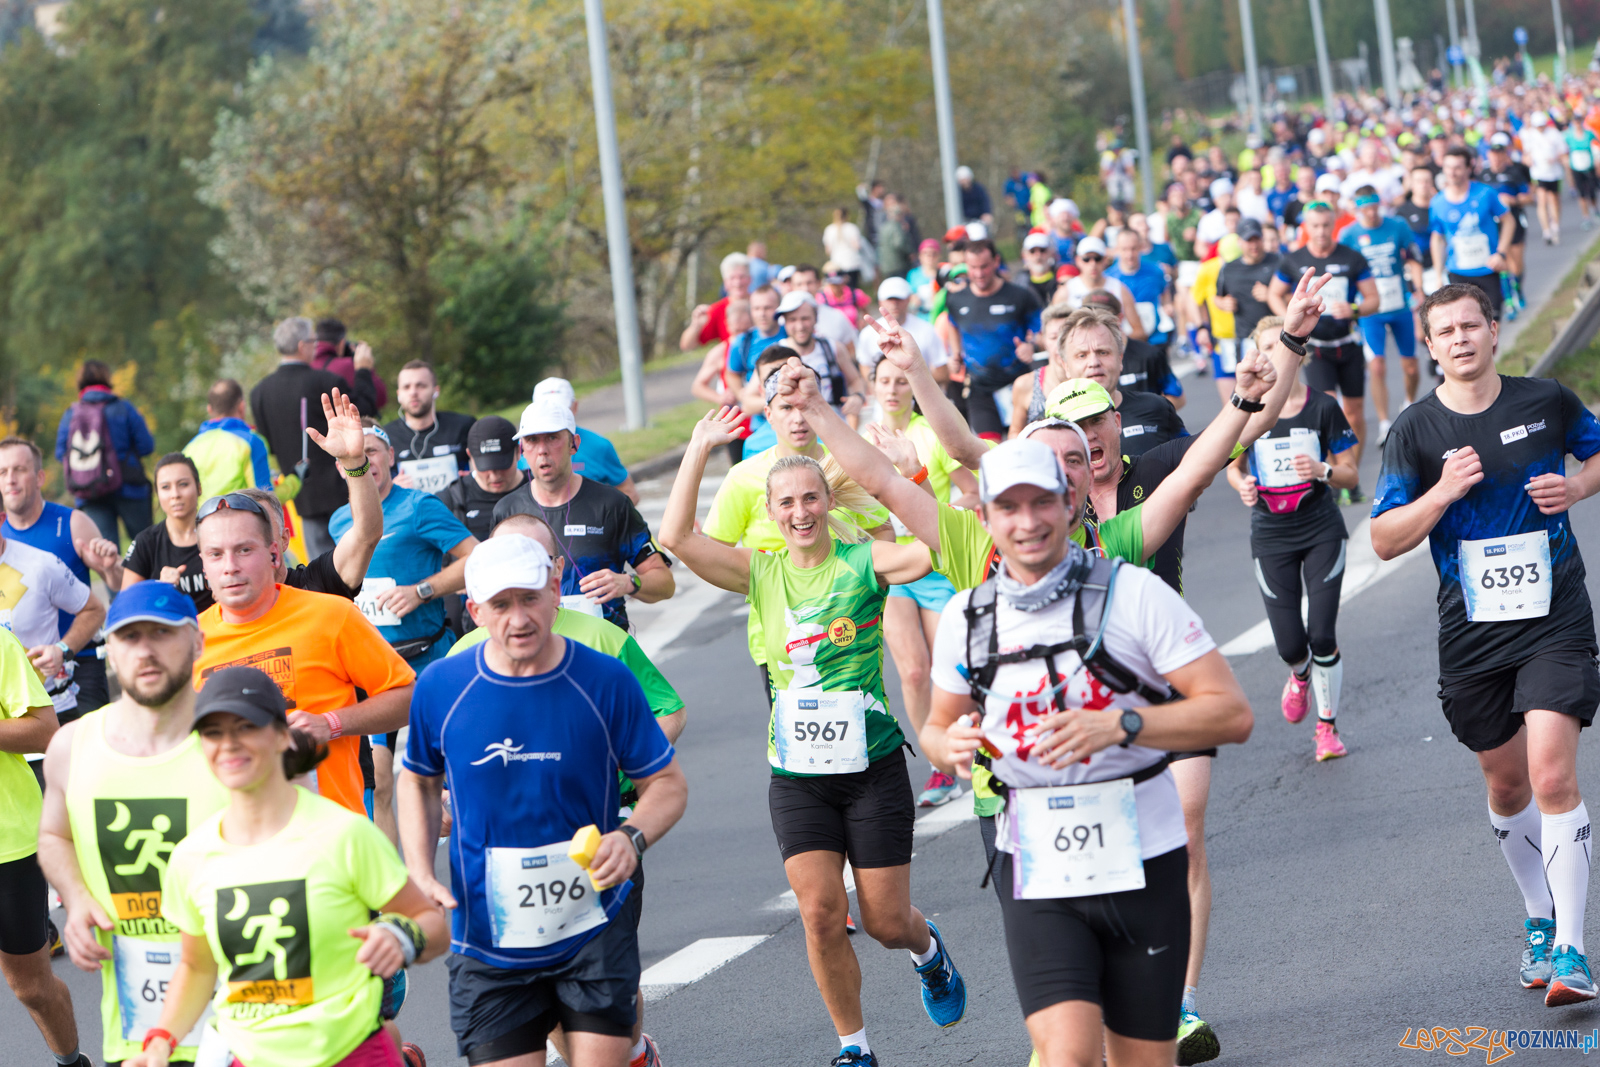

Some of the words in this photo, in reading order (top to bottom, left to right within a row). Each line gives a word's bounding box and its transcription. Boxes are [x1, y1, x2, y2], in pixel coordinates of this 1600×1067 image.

[1512, 429, 1525, 437] PKO
[1493, 546, 1505, 554] PKO
[1481, 562, 1540, 589] 6393
[1501, 588, 1523, 596] Marek
[788, 639, 809, 650] Kamila
[213, 650, 276, 673] FINISHER
[794, 721, 849, 741] 5967
[1054, 823, 1104, 852] 691
[531, 858, 547, 867] PKO
[517, 876, 586, 908] 2196
[127, 894, 160, 918] nig
[544, 906, 564, 915] Piotr
[141, 978, 171, 1003] 65
[241, 979, 297, 1001] night
